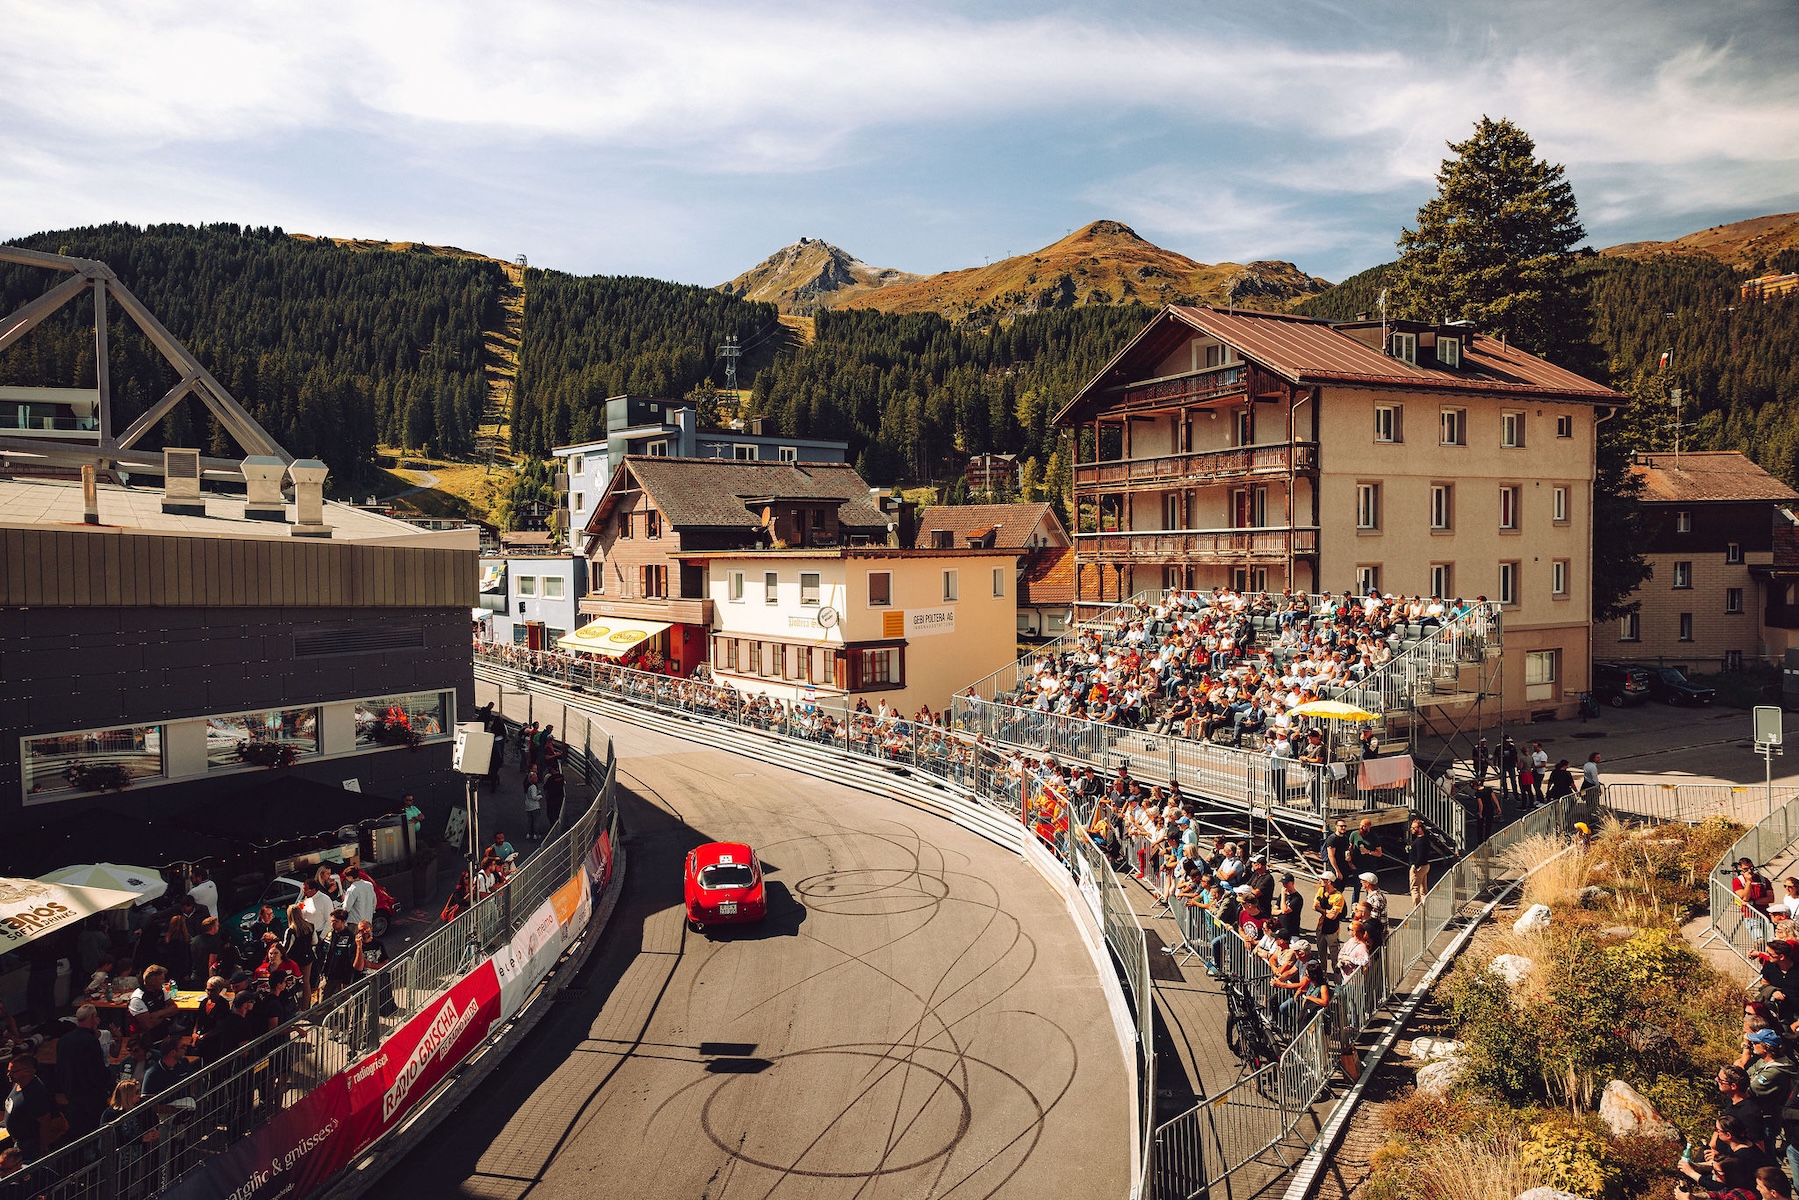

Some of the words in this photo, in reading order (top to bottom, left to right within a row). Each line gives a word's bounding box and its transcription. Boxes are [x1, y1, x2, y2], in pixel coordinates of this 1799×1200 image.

[913, 615, 925, 625] GEBI
[925, 613, 945, 624] POLTERA
[946, 612, 954, 621] AG
[6, 925, 34, 941] SOFT
[40, 909, 77, 926] DRINKS
[448, 1021, 464, 1046] RADIO
[385, 1060, 417, 1115] RADIO
[418, 1005, 457, 1066] GRISCHA
[225, 1169, 269, 1200] atgific
[271, 1157, 284, 1176] &
